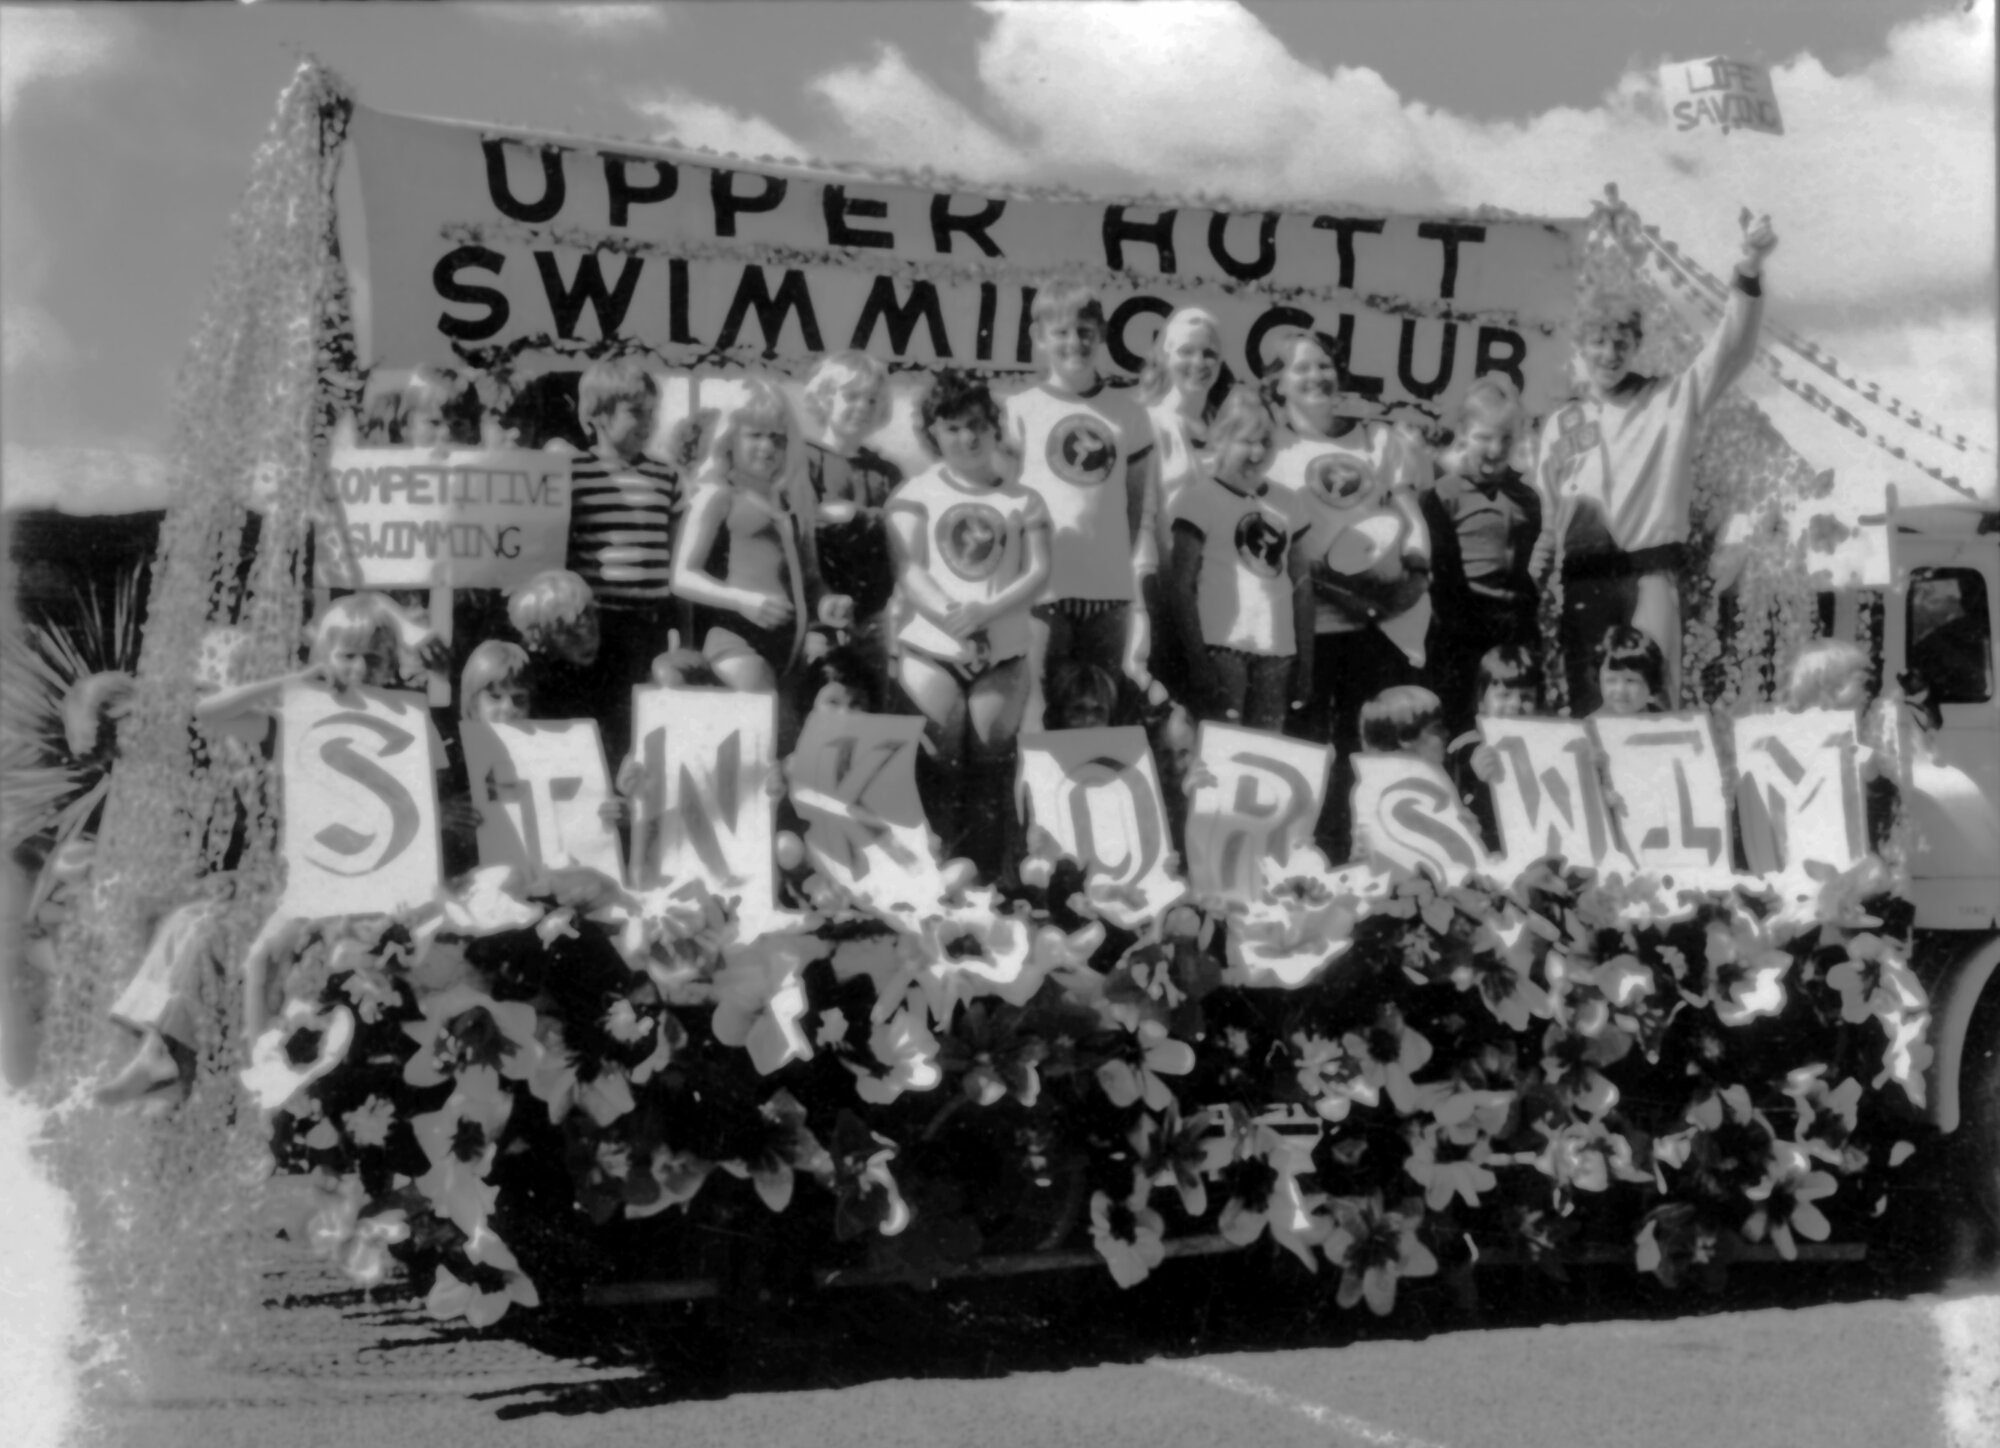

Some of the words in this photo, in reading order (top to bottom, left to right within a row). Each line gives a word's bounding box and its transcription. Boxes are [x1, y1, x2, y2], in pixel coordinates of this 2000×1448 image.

[1686, 57, 1757, 93] LIFE
[480, 137, 1006, 258] UPPER
[1103, 204, 1487, 300] HUTT
[1245, 306, 1527, 402] CLUB
[1060, 751, 1313, 890] OR
[1378, 730, 1866, 887] SWIM
